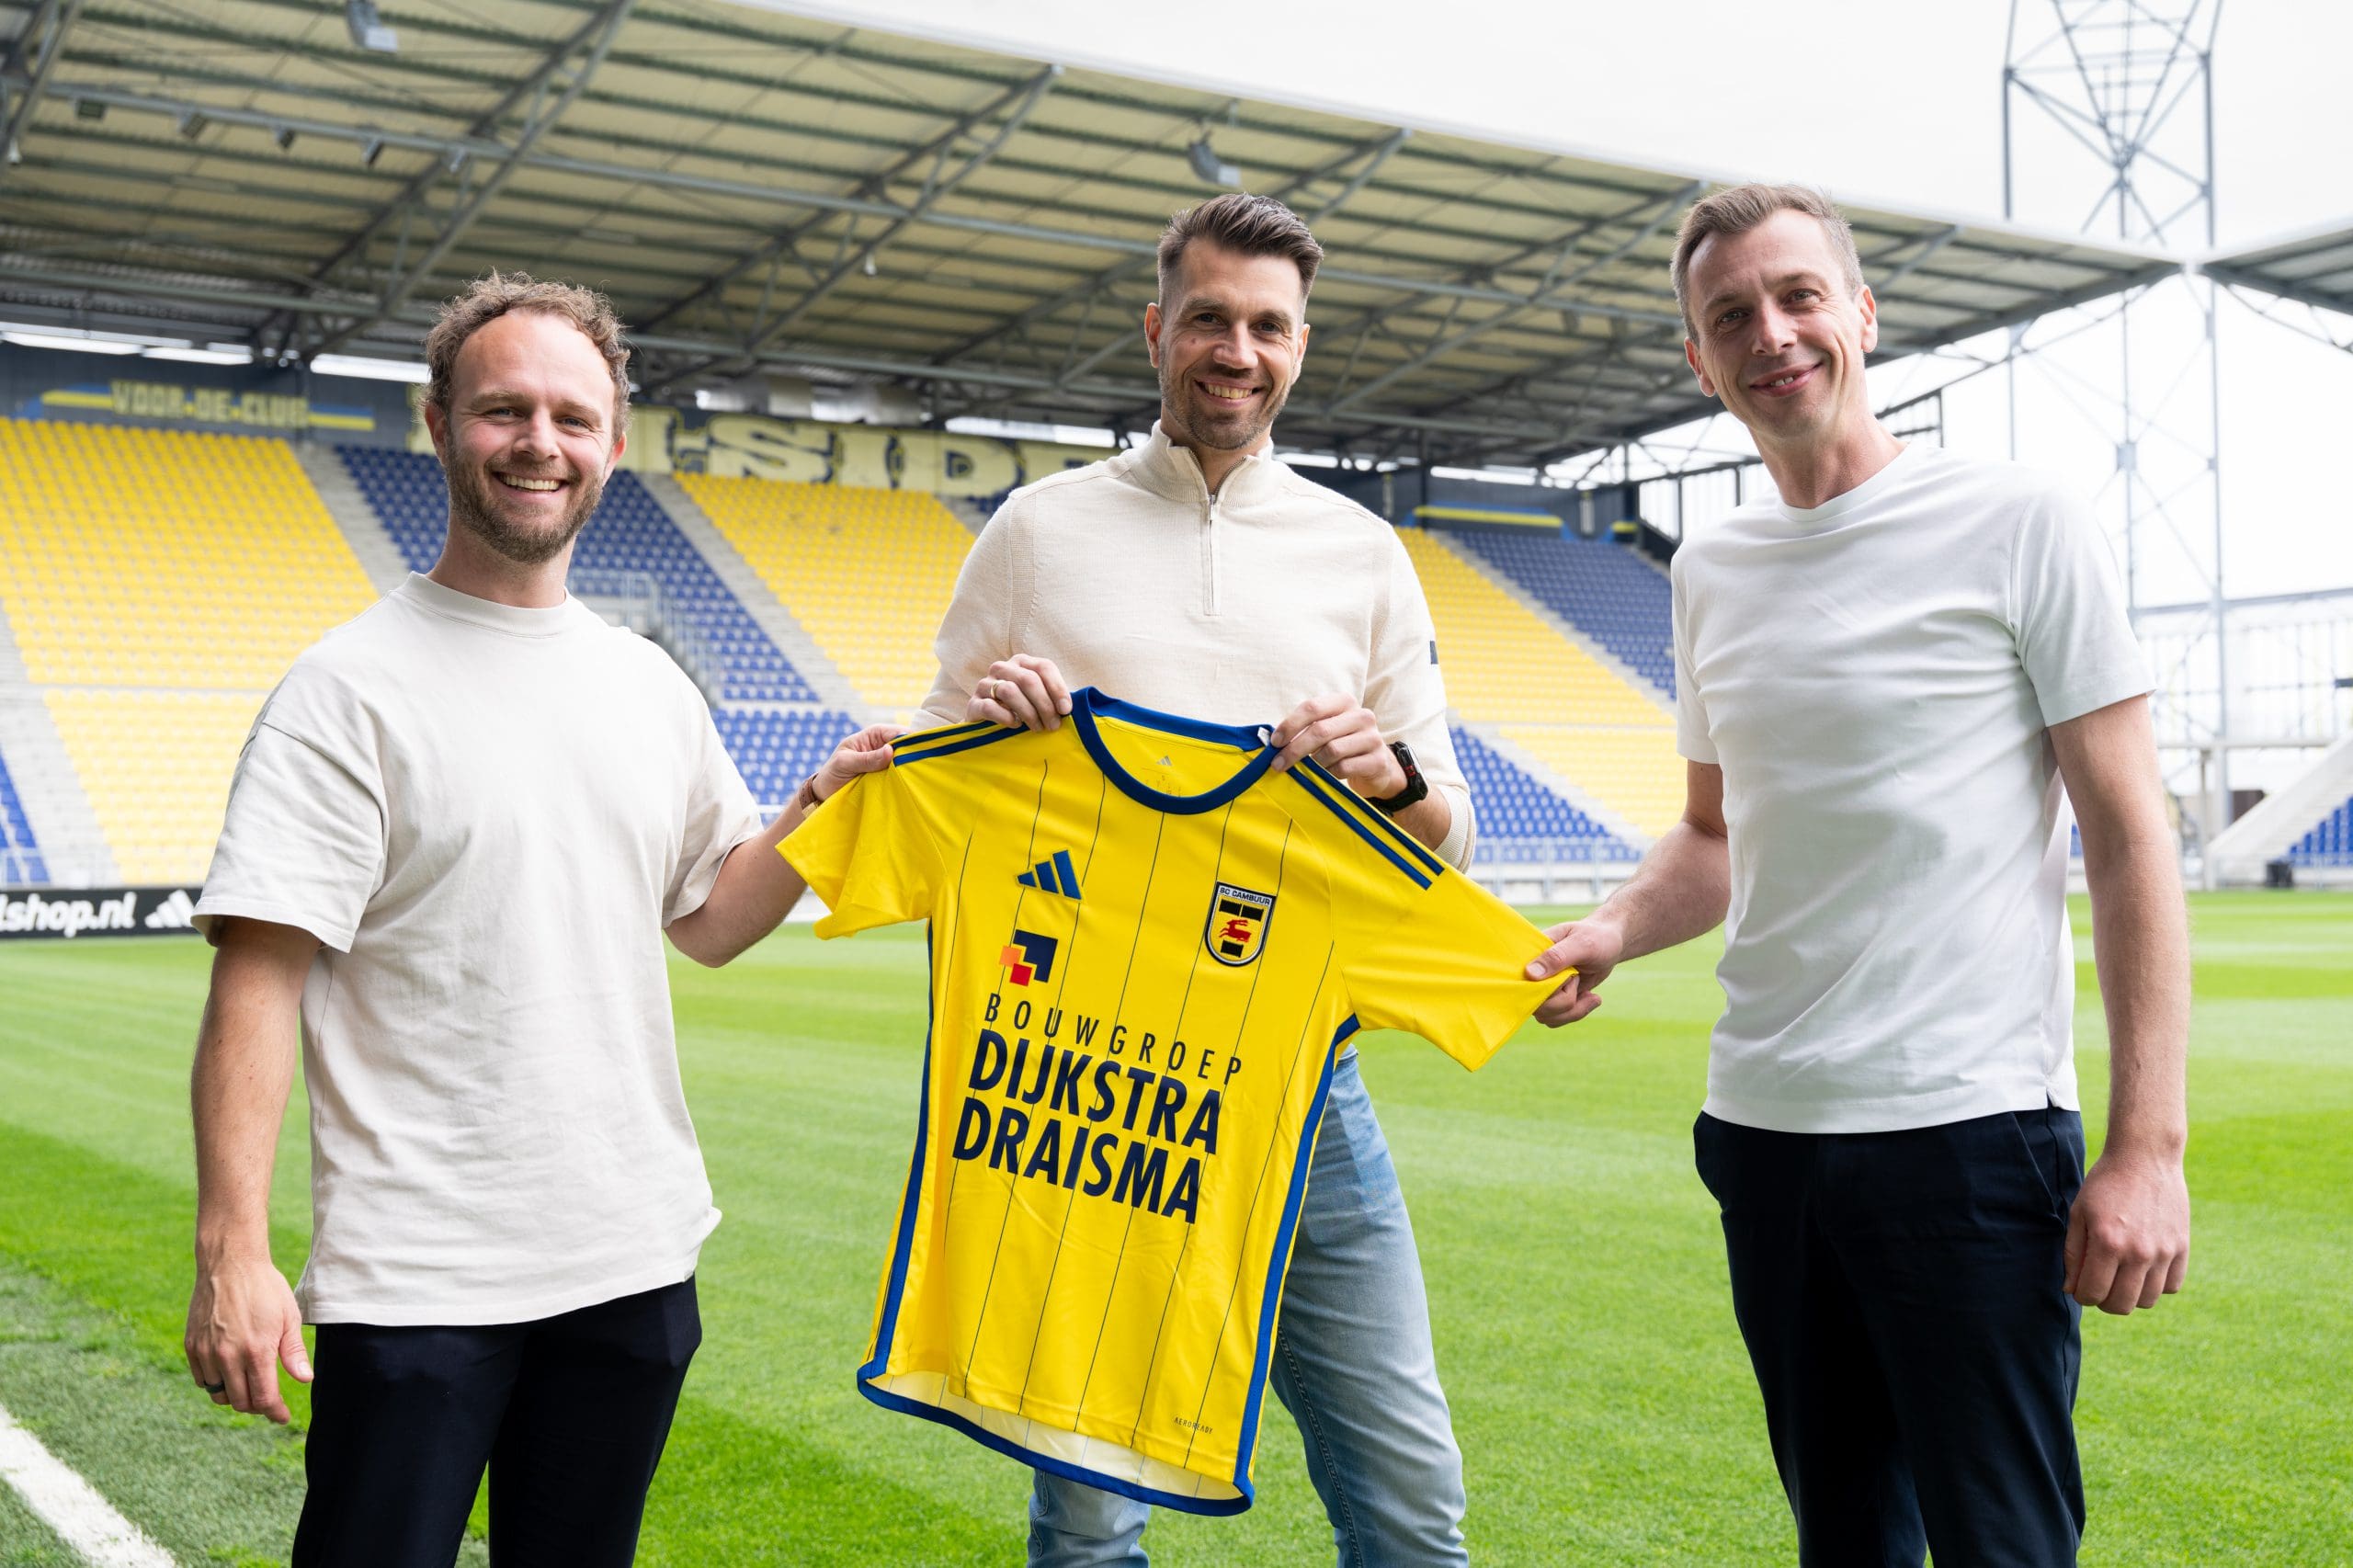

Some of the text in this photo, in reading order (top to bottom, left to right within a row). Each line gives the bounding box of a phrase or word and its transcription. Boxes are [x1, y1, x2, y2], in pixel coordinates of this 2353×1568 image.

[1220, 887, 1270, 905] SC CAMBUUR
[984, 994, 1242, 1085] BOUWGROEP
[968, 1028, 1221, 1154] DIJKSTRA
[952, 1096, 1200, 1224] DRAISMA
[1174, 1416, 1213, 1434] AEROREADY
